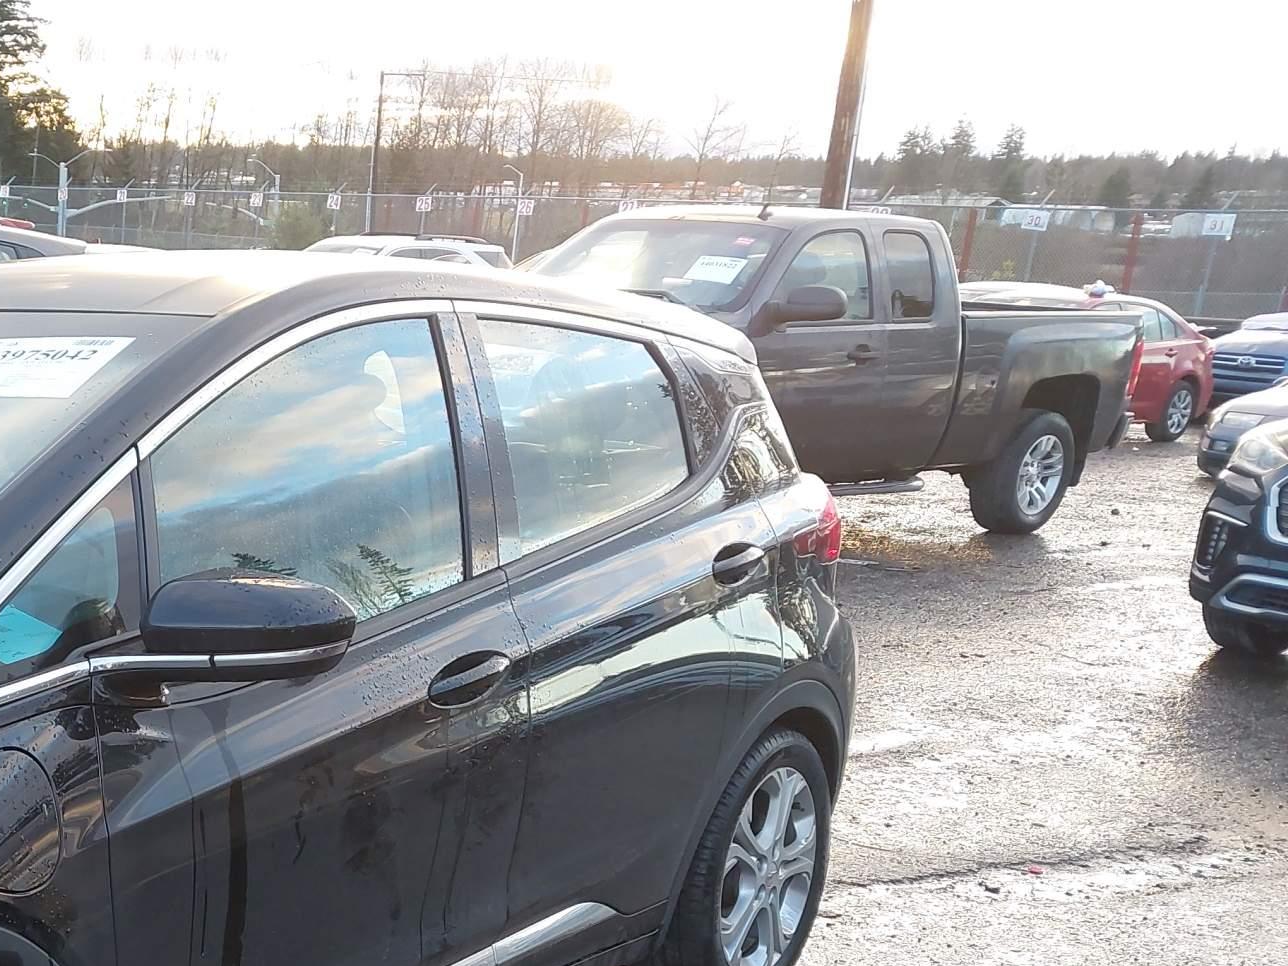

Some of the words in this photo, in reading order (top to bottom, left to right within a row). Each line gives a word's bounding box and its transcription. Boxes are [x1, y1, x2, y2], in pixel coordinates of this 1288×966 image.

[328, 195, 339, 208] 24
[417, 197, 430, 210] 25
[518, 200, 532, 214] 26
[1027, 214, 1041, 226] 30
[1209, 219, 1224, 231] 31
